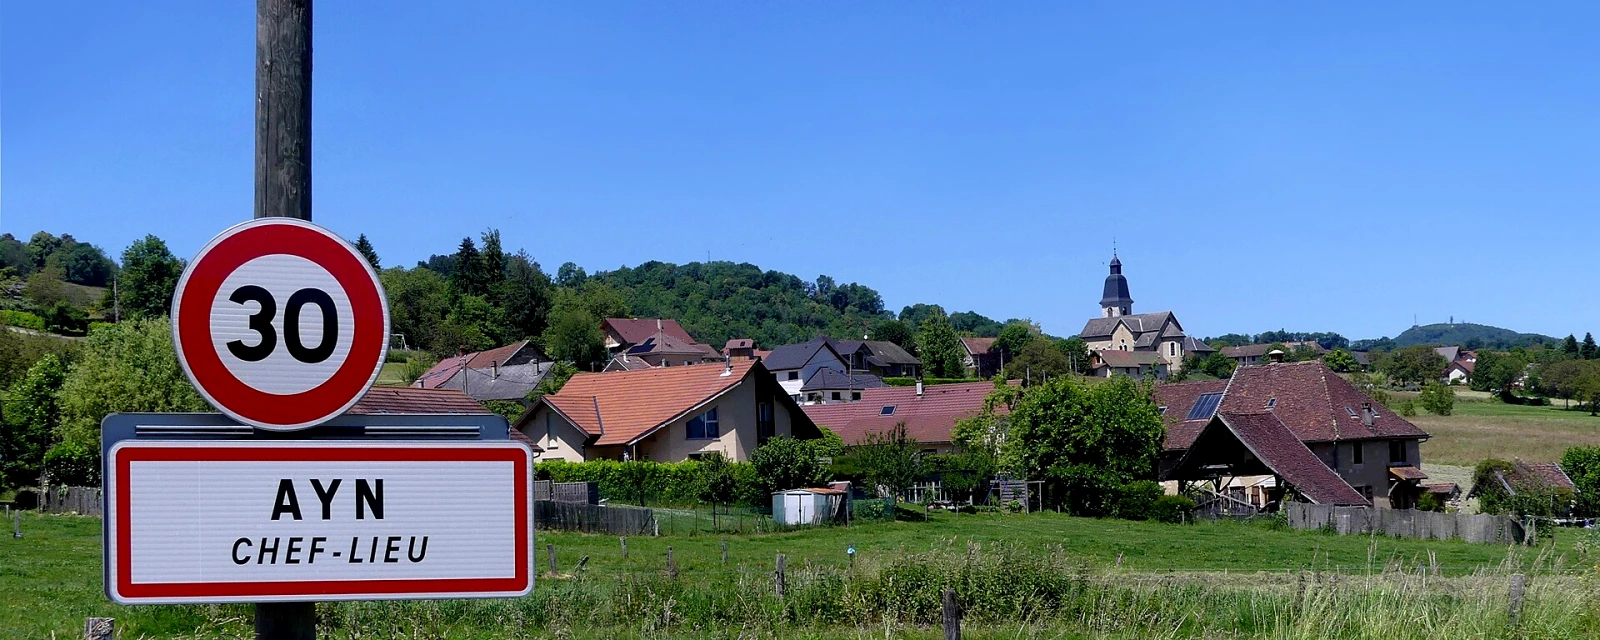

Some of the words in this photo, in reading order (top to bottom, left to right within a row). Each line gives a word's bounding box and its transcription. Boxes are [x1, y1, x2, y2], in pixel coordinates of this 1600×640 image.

[226, 285, 339, 363] 30
[270, 478, 384, 520] AYN
[231, 537, 429, 565] CHEF-LIEU
